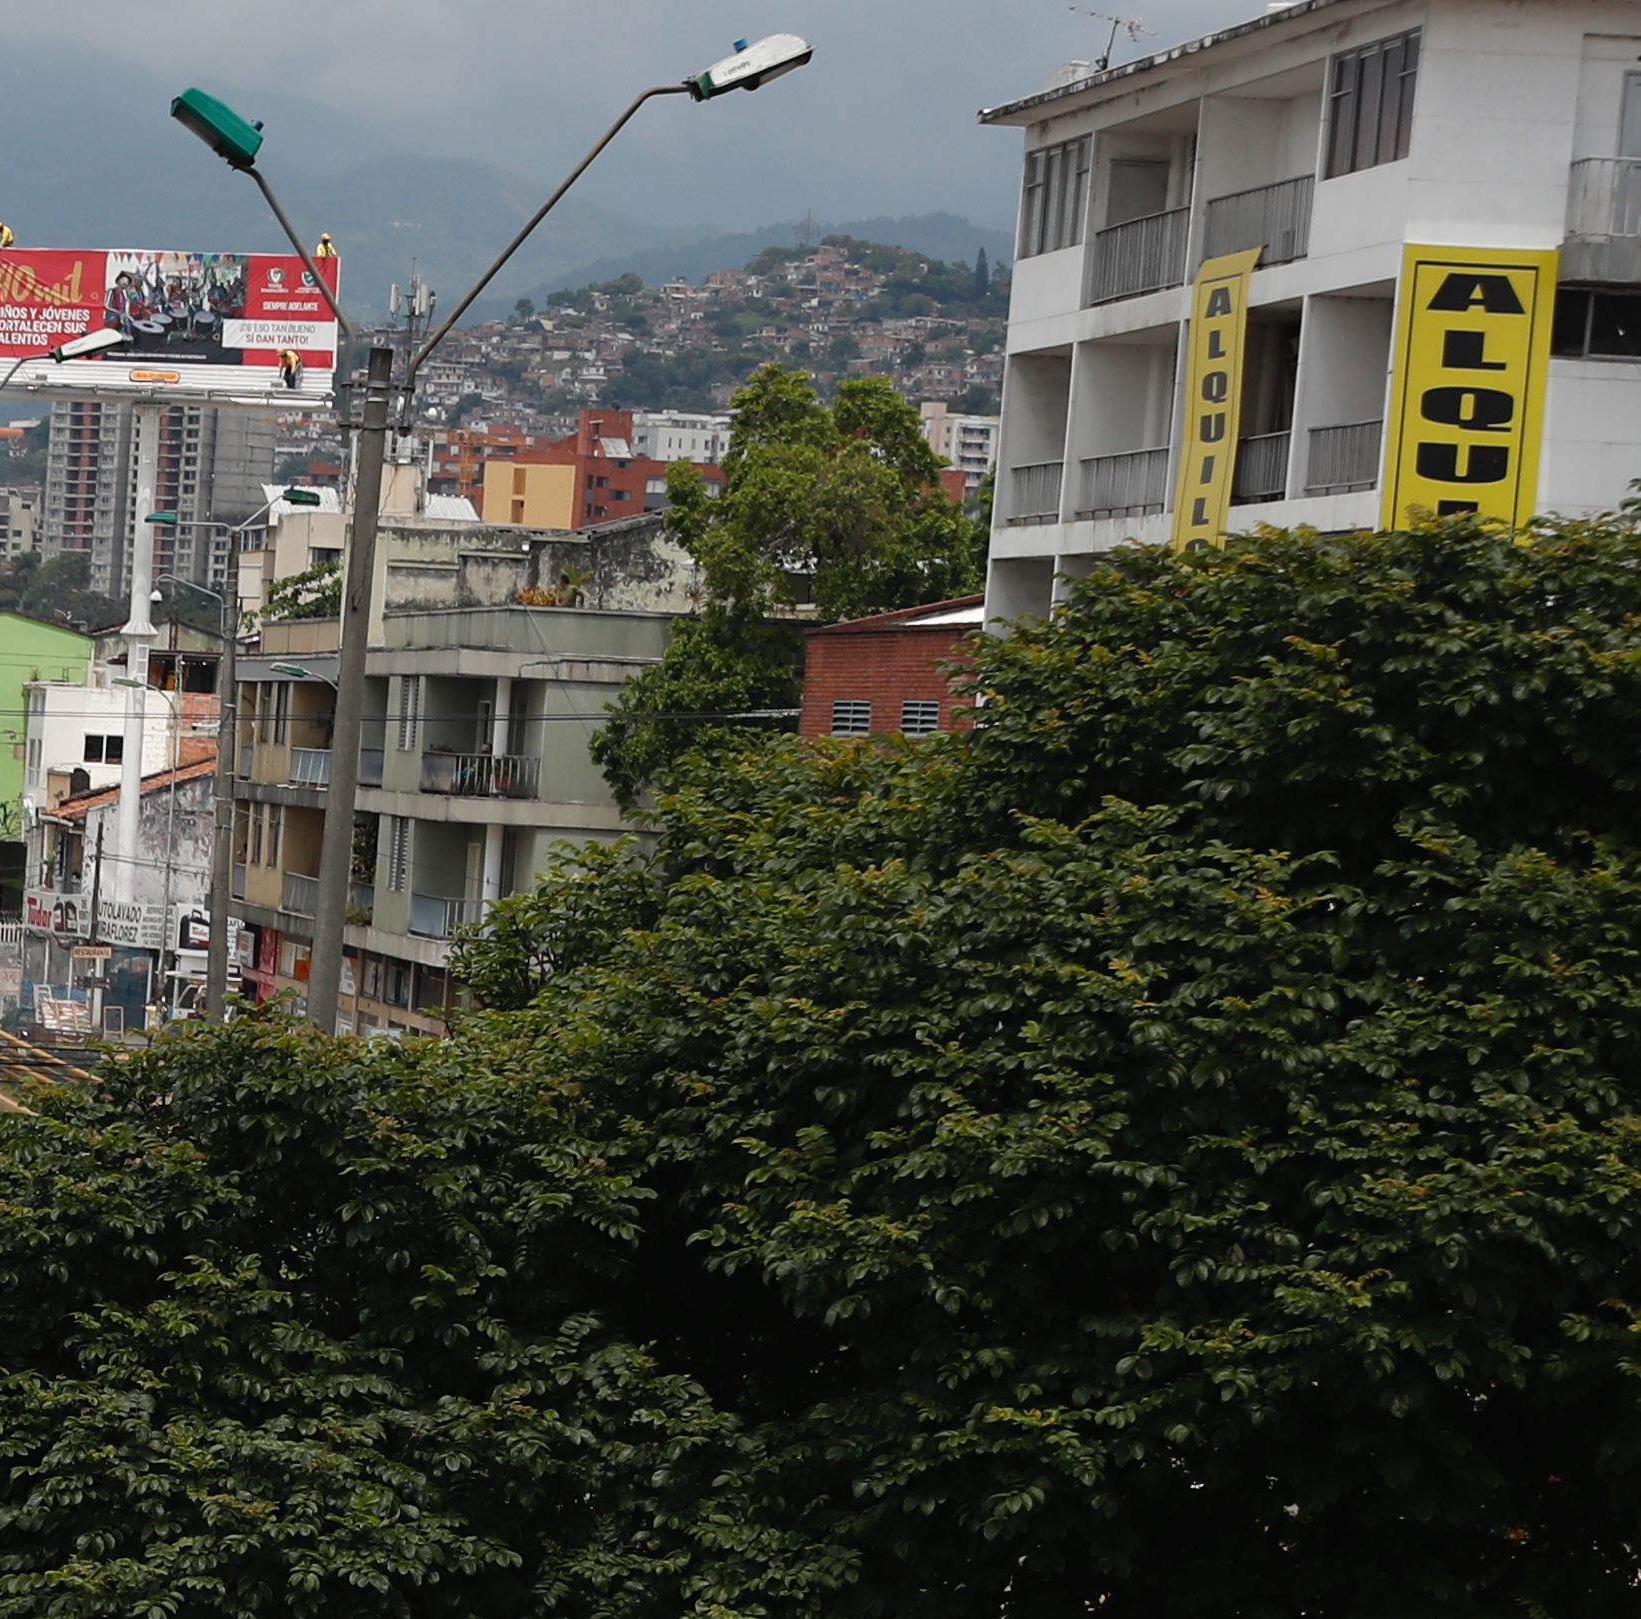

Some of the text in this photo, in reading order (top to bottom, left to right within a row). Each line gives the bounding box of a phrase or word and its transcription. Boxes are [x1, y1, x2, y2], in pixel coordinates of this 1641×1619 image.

[30, 307, 37, 319] Y
[39, 306, 91, 321] JÓVENES
[63, 321, 87, 334] SUS
[256, 334, 274, 344] DAN
[275, 334, 309, 345] TANTO!
[27, 896, 52, 928] Tudor
[98, 901, 142, 924] UTOLAVADO
